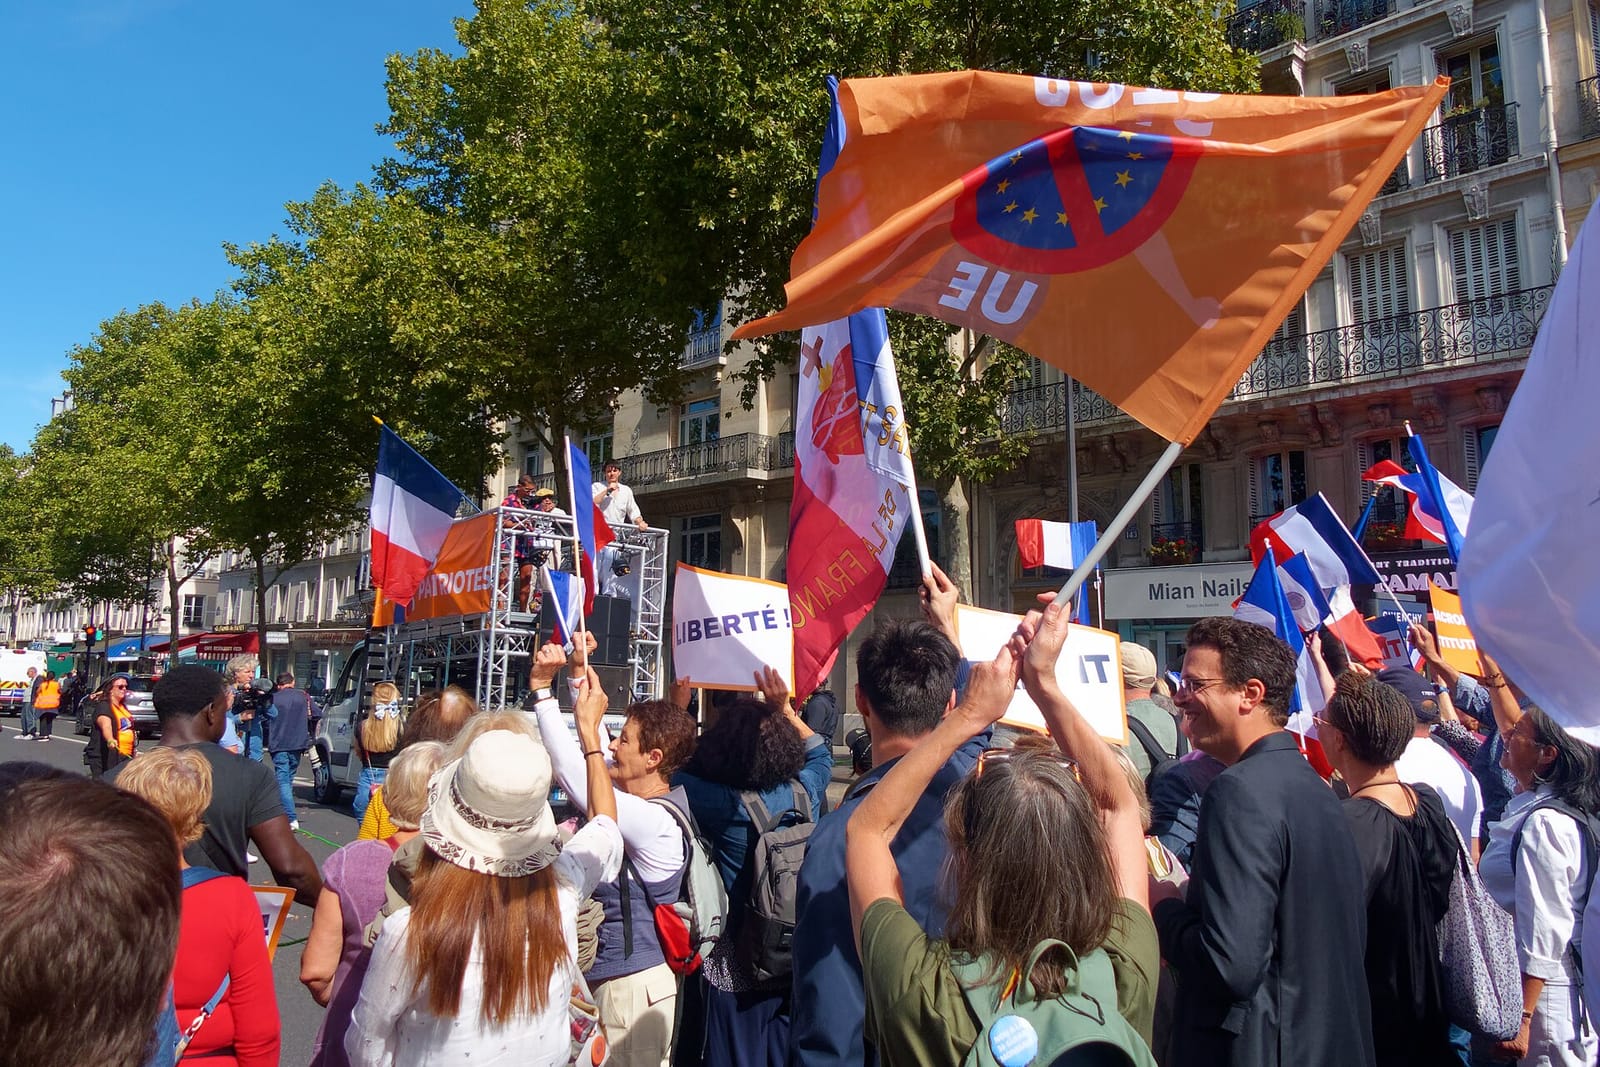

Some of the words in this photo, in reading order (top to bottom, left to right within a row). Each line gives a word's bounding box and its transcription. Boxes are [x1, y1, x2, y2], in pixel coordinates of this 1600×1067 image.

[419, 565, 494, 601] PATRIOTES
[1149, 583, 1194, 600] Mian
[1202, 578, 1250, 598] Nails
[676, 603, 778, 646] LIBERTÉ
